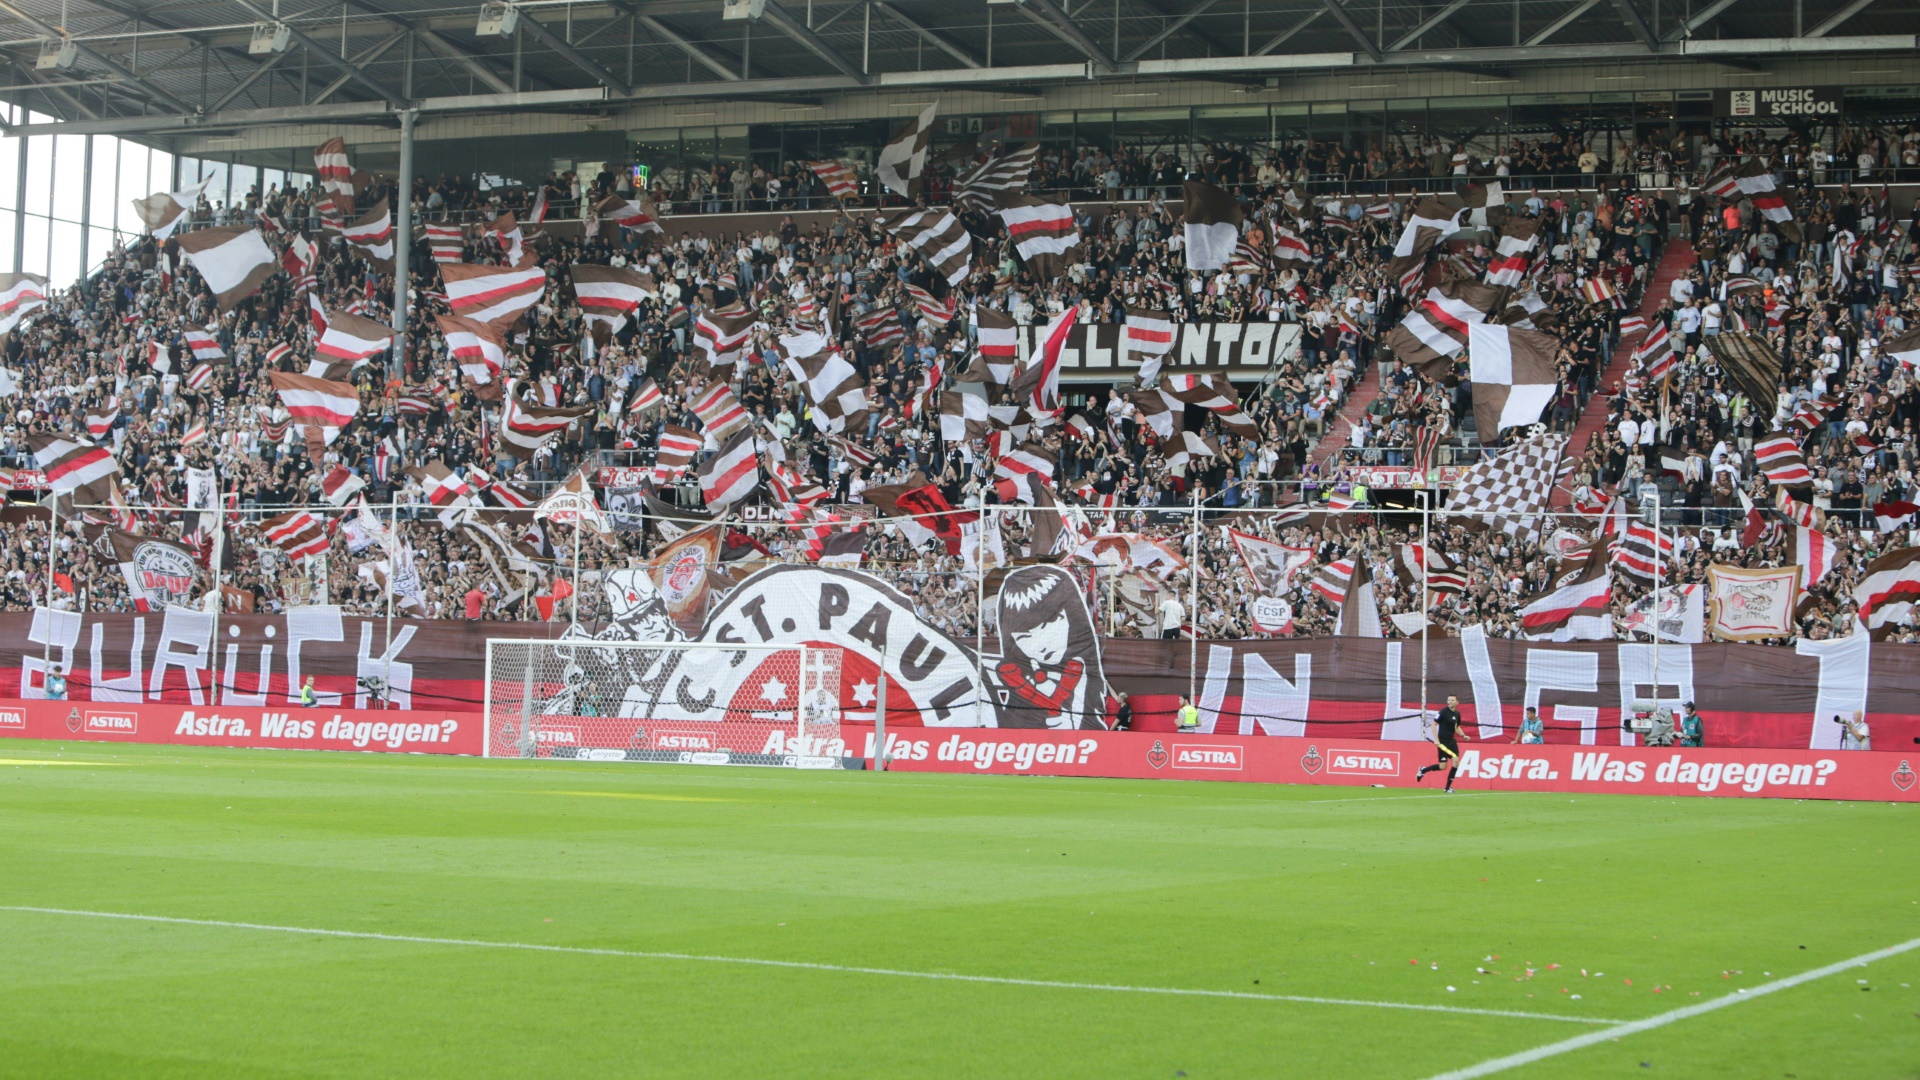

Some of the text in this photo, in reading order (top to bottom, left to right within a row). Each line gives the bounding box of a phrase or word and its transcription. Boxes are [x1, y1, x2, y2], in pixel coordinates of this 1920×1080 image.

[1761, 89, 1814, 103] MUSIC
[1771, 101, 1839, 115] SCHOOL
[165, 551, 183, 562] MIT
[1257, 605, 1286, 616] FCSP
[716, 594, 796, 668] ST.
[819, 582, 976, 722] PAUL
[1195, 623, 1870, 751] IN LIGA 1
[89, 715, 133, 729] ASTRA
[175, 711, 458, 748] Astra. Was dagegen?
[658, 735, 710, 749] ASTRA
[762, 729, 1098, 771] Astra. Was dagegen?
[1178, 750, 1237, 764] ASTRA
[802, 758, 832, 767] ongstar
[1333, 756, 1393, 770] ASTRA
[1455, 750, 1838, 793] Astra. Was dagegen?
